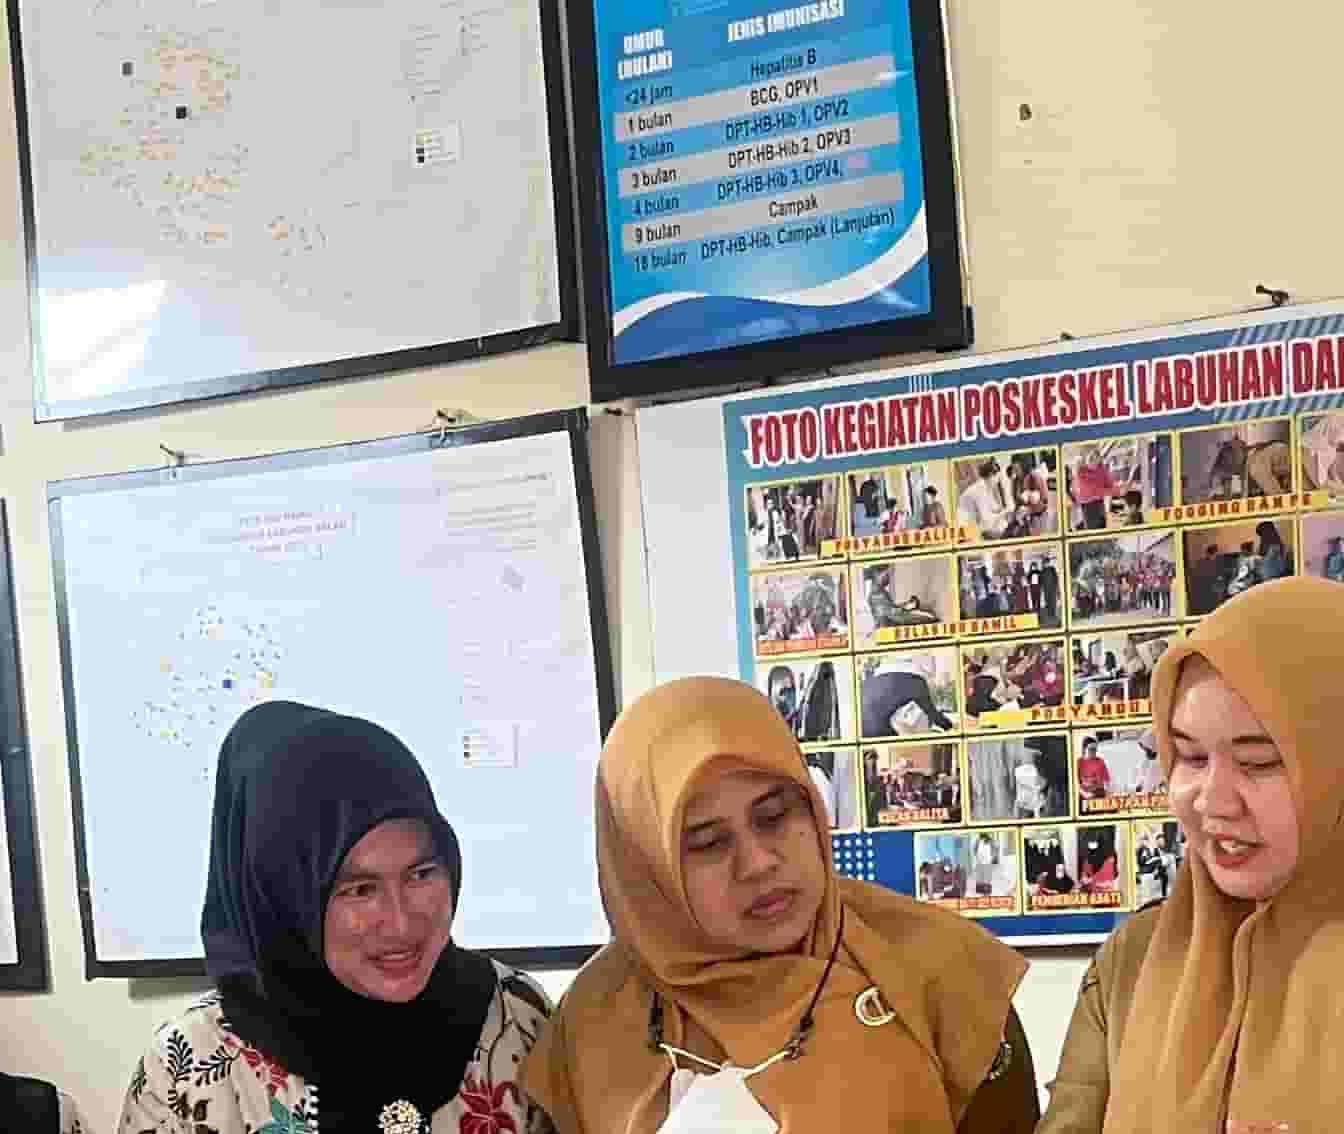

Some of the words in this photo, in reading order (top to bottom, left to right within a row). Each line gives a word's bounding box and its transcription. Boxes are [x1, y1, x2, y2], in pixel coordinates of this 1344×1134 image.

[807, 48, 816, 64] B
[639, 111, 672, 131] bulan
[751, 87, 782, 106] BCG,
[786, 78, 818, 99] OPV1
[640, 139, 674, 158] bulan
[814, 99, 848, 121] OPV2
[642, 168, 677, 186] bulan
[816, 129, 851, 150] OPV3
[635, 228, 643, 243] 9
[647, 224, 681, 242] bulan
[768, 193, 818, 217] Campak
[644, 196, 680, 215] bulan
[652, 250, 687, 269] bulan
[777, 221, 827, 244] Campak
[831, 208, 895, 235] (Lanjutan)
[750, 405, 819, 466] FOTO
[825, 391, 958, 454] KEGIATAN
[964, 366, 1131, 438] POSKESKEL
[1136, 341, 1283, 414] LABUHAN
